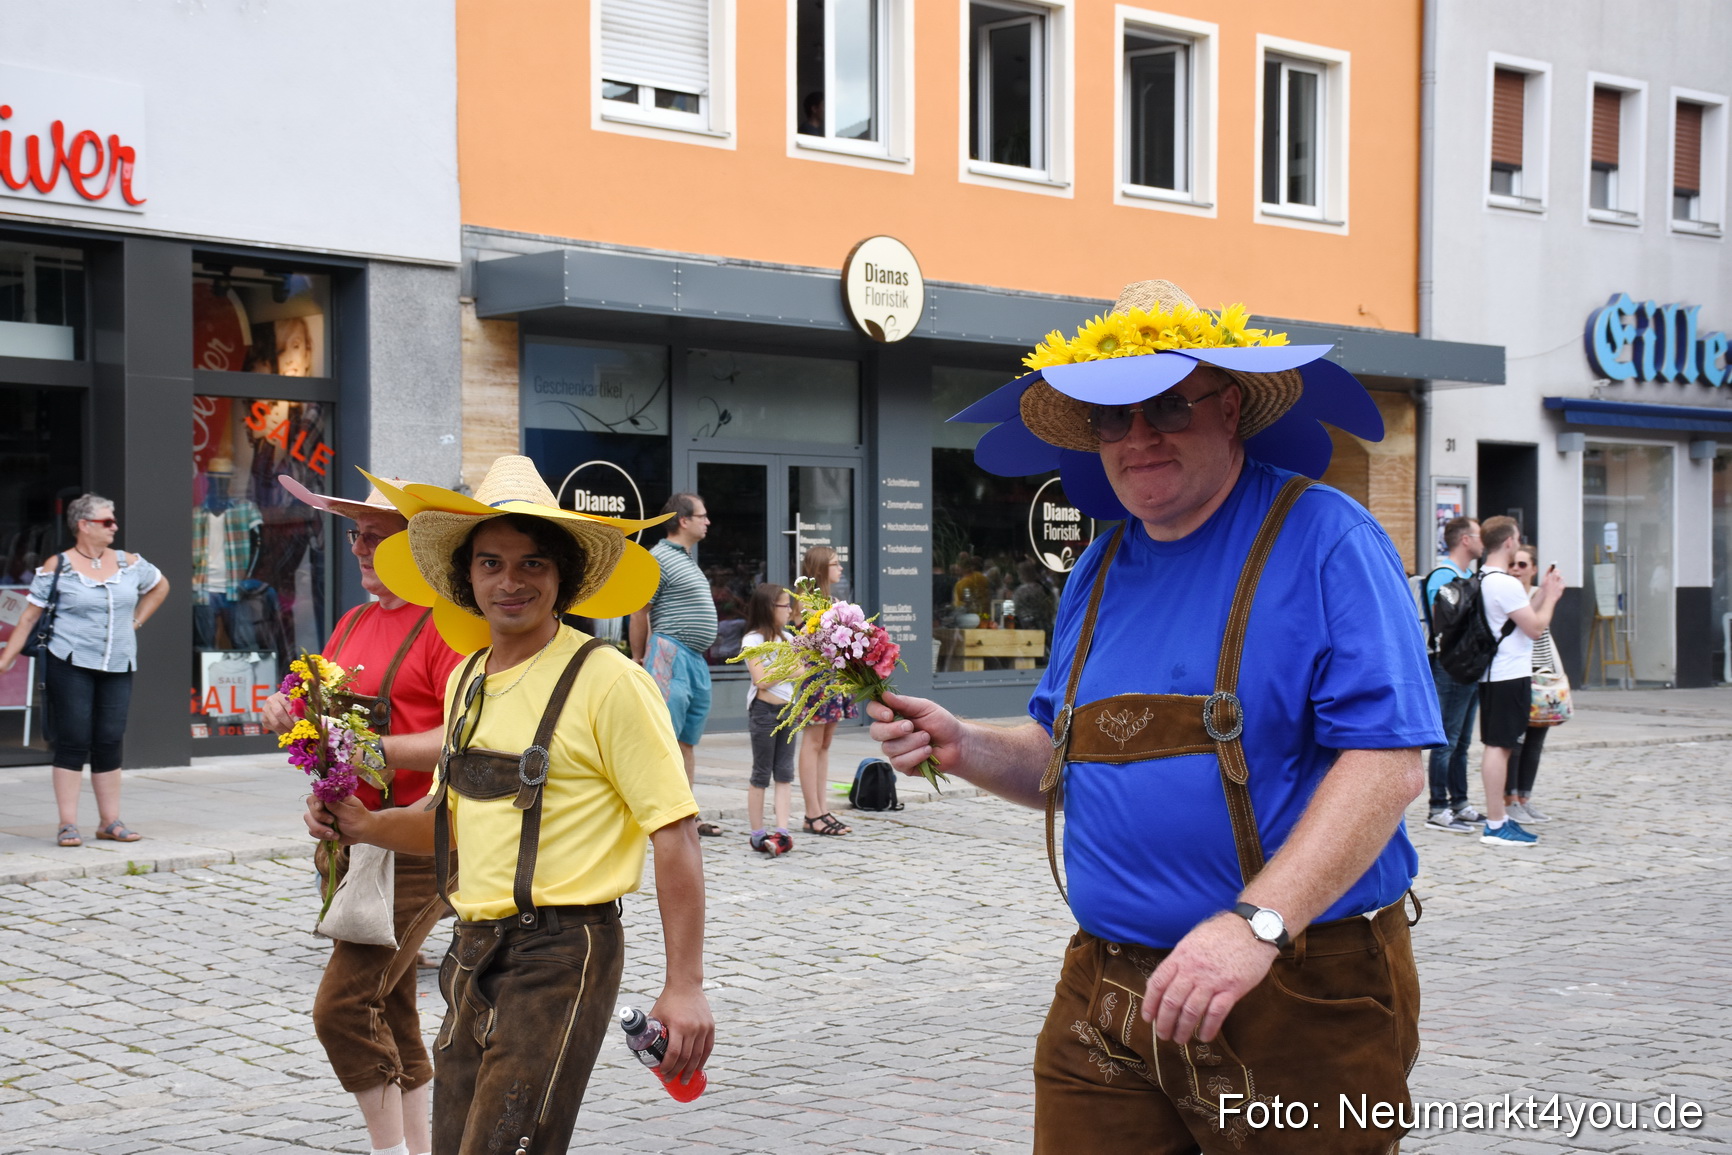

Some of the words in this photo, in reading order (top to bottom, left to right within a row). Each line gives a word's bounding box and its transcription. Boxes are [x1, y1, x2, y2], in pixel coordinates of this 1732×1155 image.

[865, 262, 909, 286] Dianas
[865, 286, 909, 309] Floristik
[1584, 292, 1732, 388] Eille
[534, 375, 623, 399] Geschenkartikel
[244, 401, 336, 476] SALE
[1445, 438, 1456, 452] 31
[574, 489, 626, 513] Dianas
[1043, 502, 1081, 522] Dianas
[1043, 523, 1081, 541] Floristik
[218, 676, 244, 685] SALE
